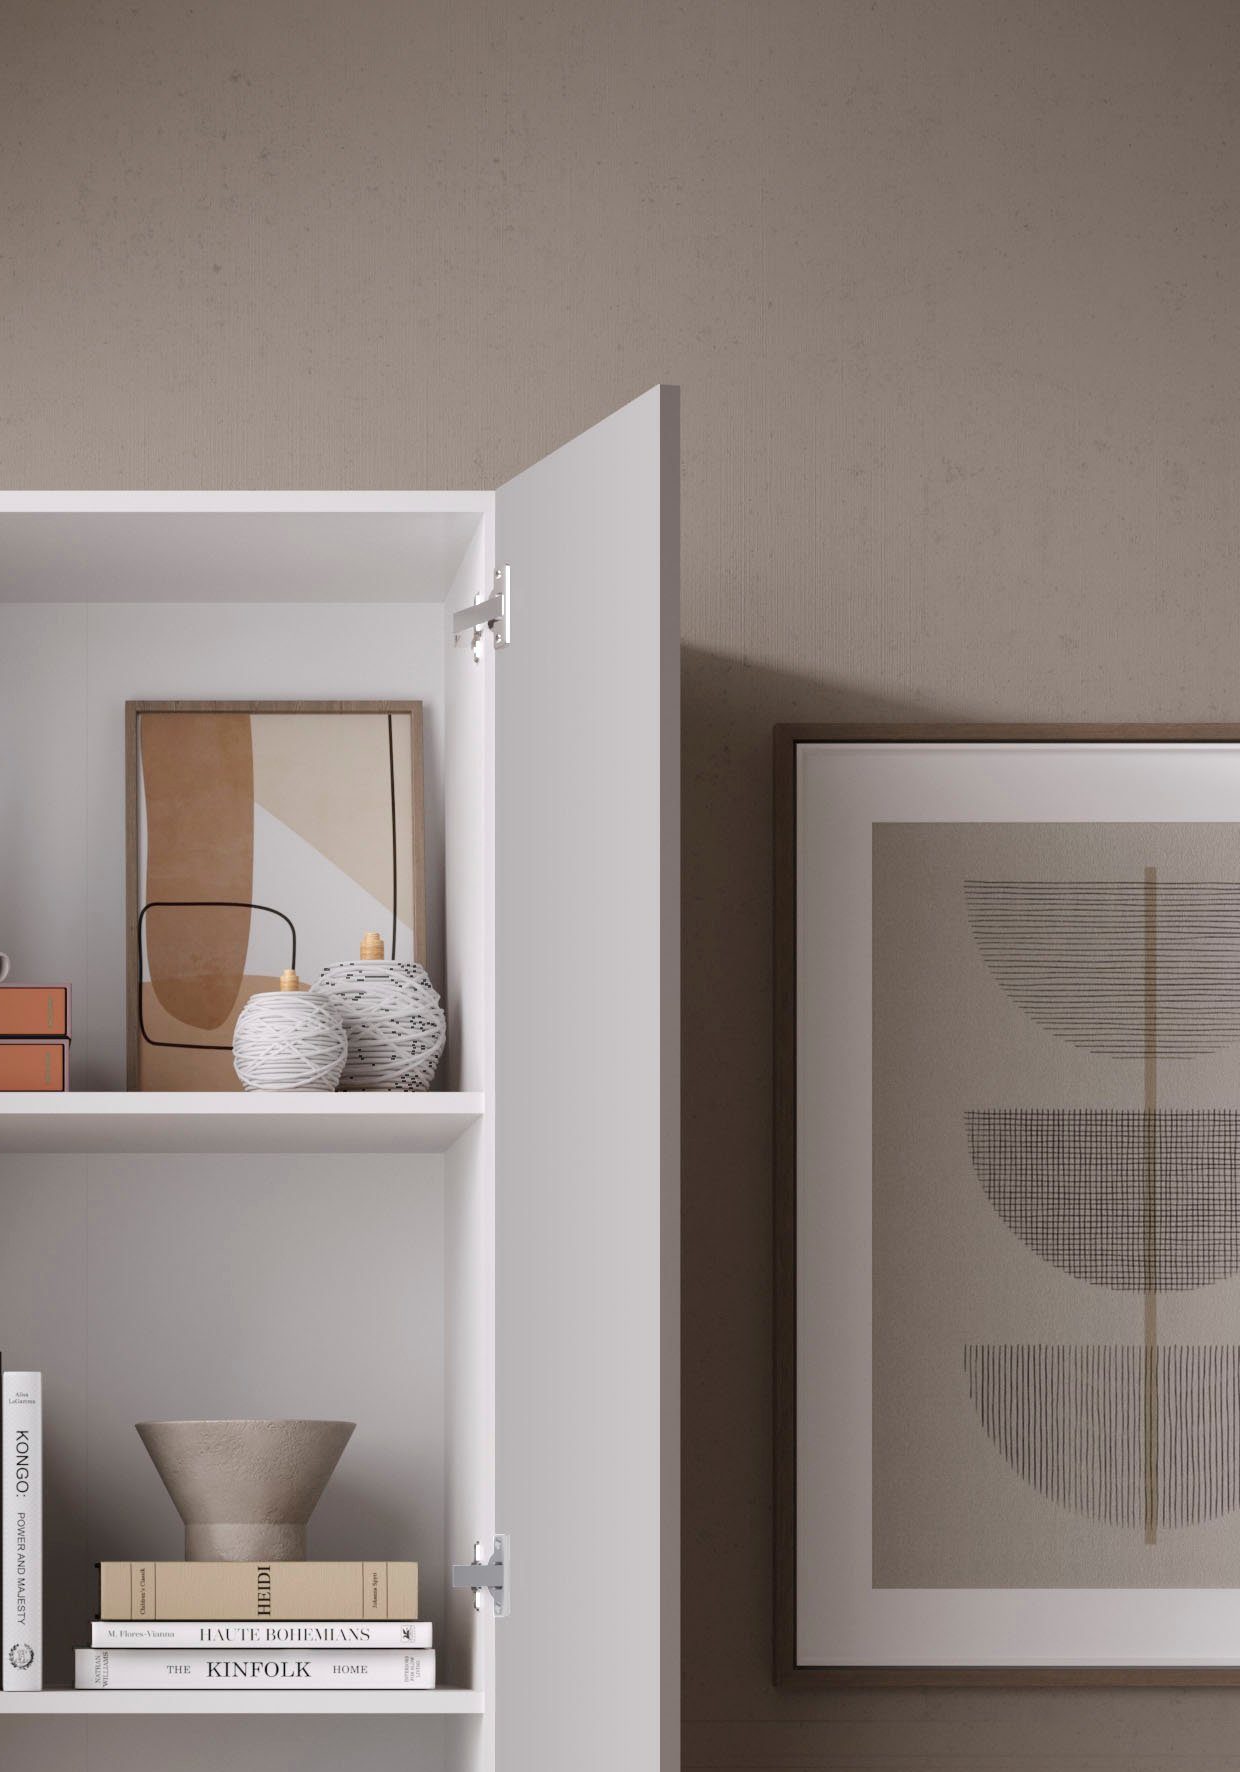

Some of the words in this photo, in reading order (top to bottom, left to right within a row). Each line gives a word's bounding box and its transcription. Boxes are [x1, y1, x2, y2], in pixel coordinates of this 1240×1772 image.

[16, 1430, 29, 1497] KONGO:
[17, 1512, 26, 1551] POWER
[17, 1553, 26, 1575] AND
[17, 1578, 26, 1625] MAJESTY
[257, 1566, 271, 1615] HEIDI
[200, 1628, 260, 1641] HAUTE
[266, 1628, 370, 1641] BOHEMIANS
[166, 1665, 191, 1674] THE
[207, 1662, 310, 1677] KINFOLK
[333, 1665, 368, 1674] HOME
